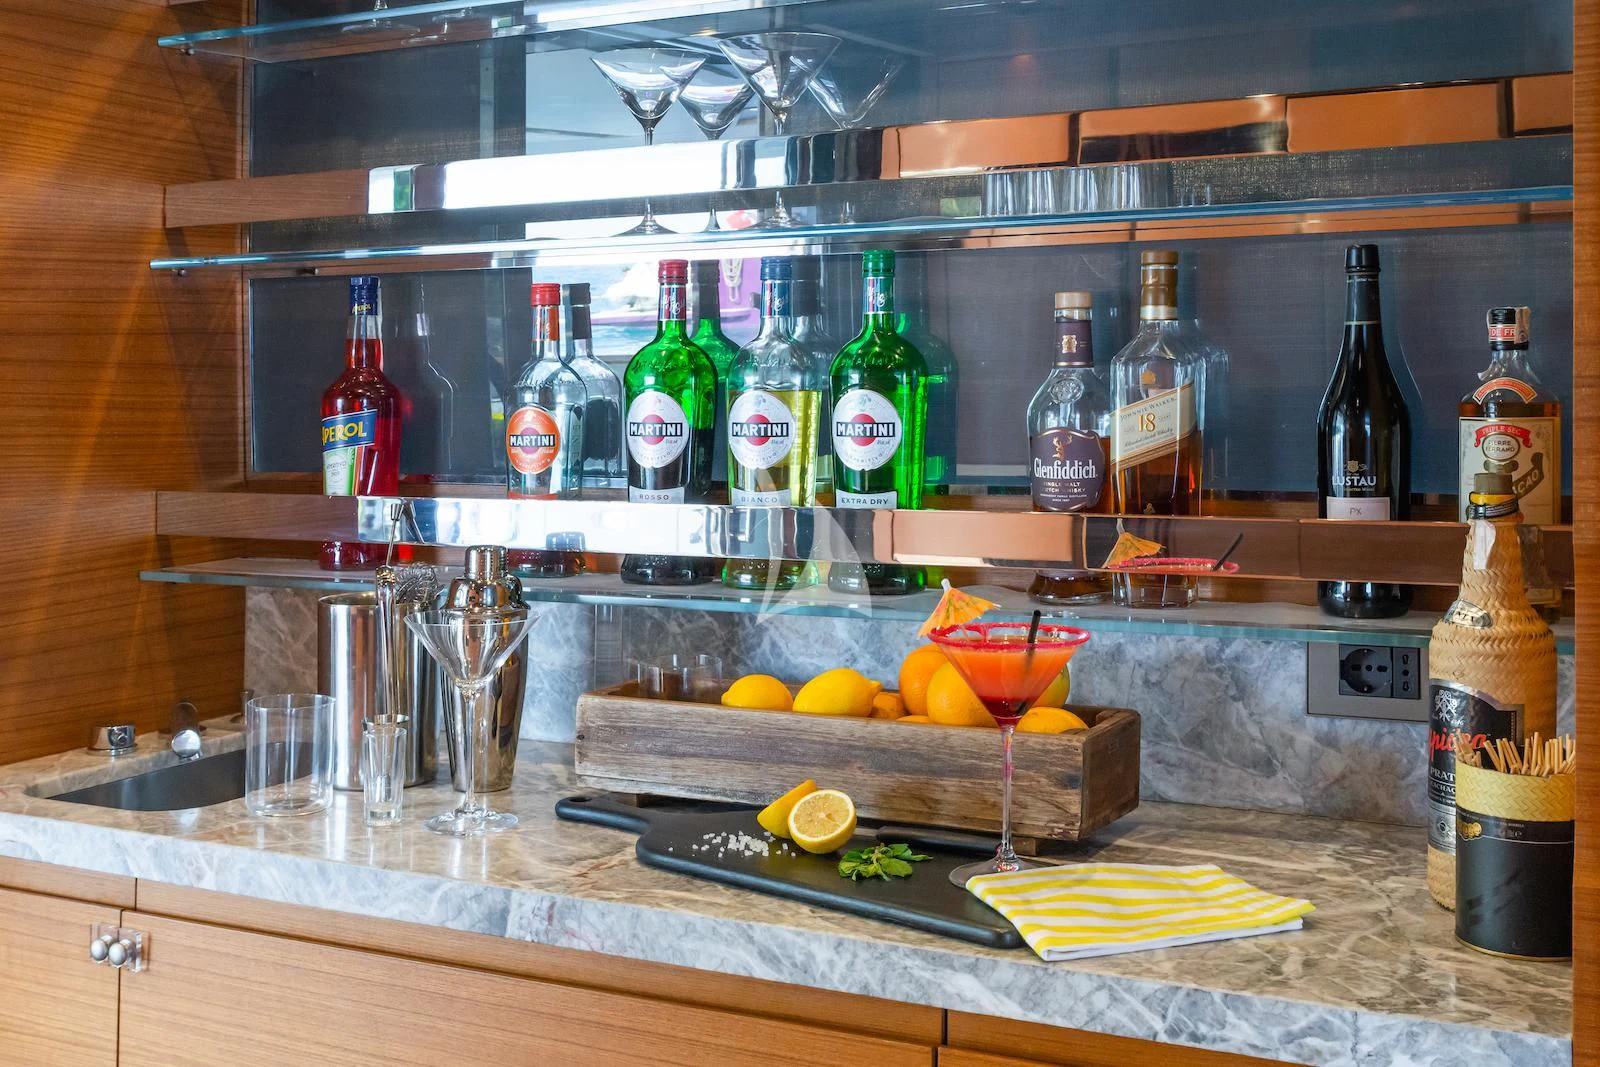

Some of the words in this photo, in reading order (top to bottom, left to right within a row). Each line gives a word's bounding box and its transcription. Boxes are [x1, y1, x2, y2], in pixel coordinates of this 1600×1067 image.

[1138, 412, 1156, 433] 18
[630, 423, 681, 436] MARTINI
[733, 423, 788, 436] MARTINI
[837, 423, 894, 437] MARTINI
[510, 435, 554, 446] MARTINI
[1034, 457, 1096, 480] Glenfiddich
[1332, 475, 1377, 486] LUSTAU
[841, 497, 867, 505] EXTRA
